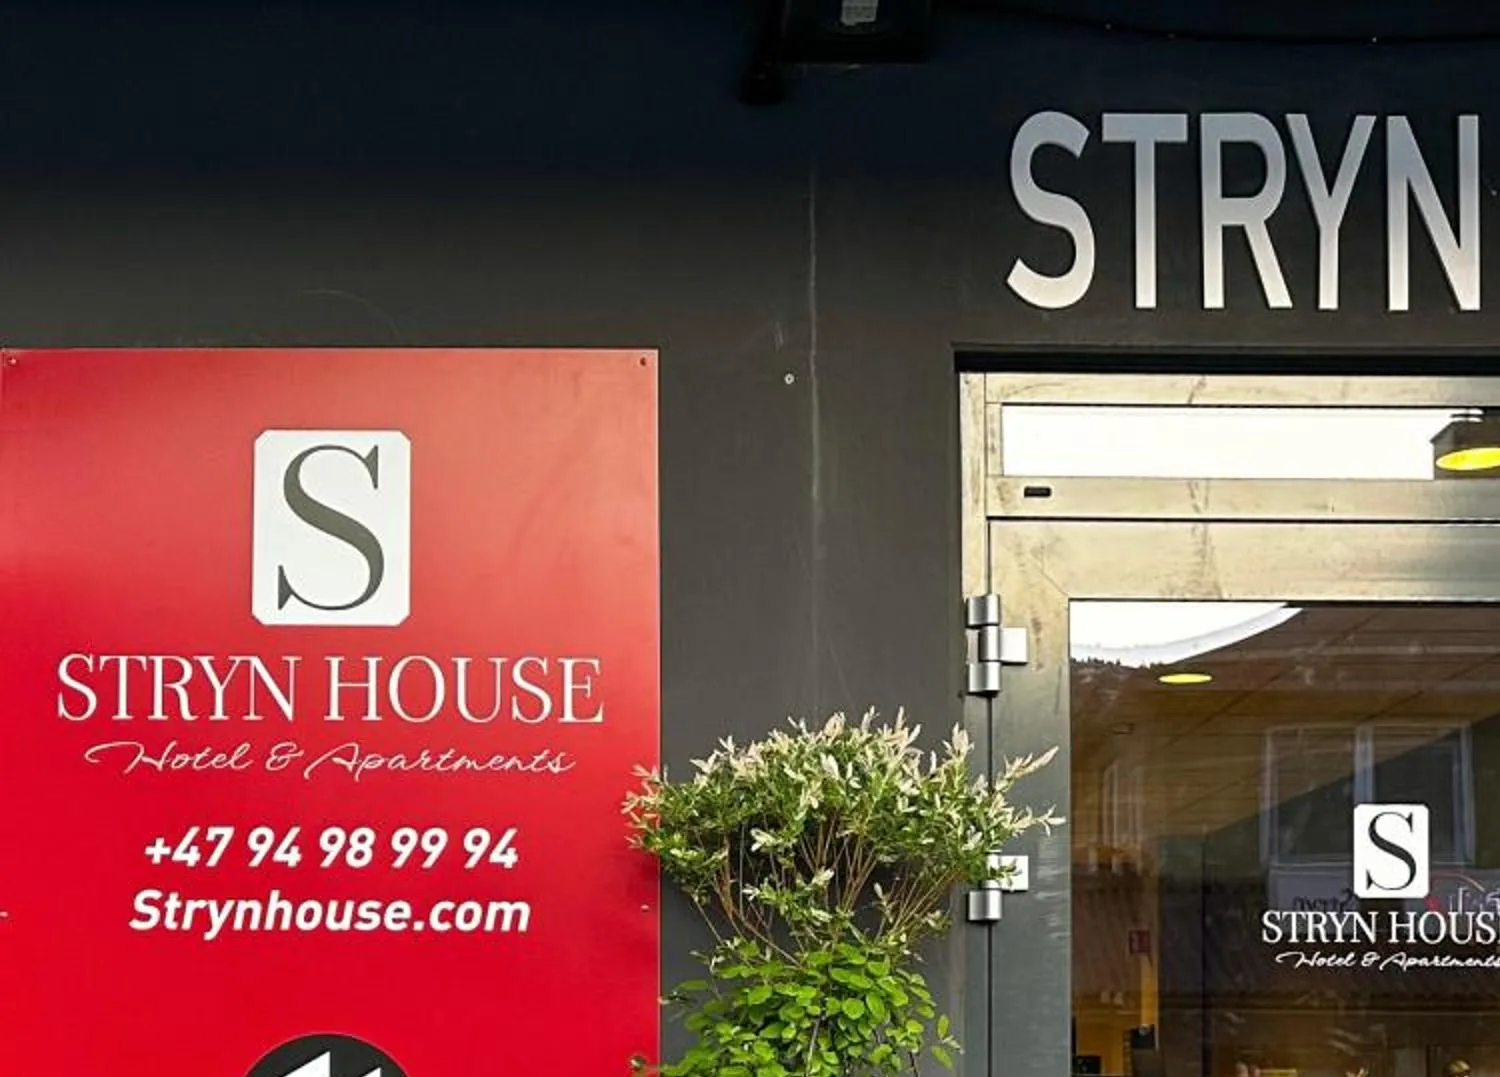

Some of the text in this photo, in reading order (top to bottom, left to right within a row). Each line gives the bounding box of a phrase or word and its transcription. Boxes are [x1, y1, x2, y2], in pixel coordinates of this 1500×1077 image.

[1006, 110, 1481, 312] STRYN
[277, 445, 385, 611] S
[57, 654, 604, 723] STRYN HOUSE
[85, 741, 576, 781] Hotel & Apartments
[145, 826, 518, 868] +47 94 98 99 94
[1366, 811, 1417, 891] S
[129, 889, 531, 940] Strynhouse.com
[1262, 910, 1378, 944] STRYN
[1275, 951, 1356, 969] Hotel
[1360, 951, 1381, 968] &
